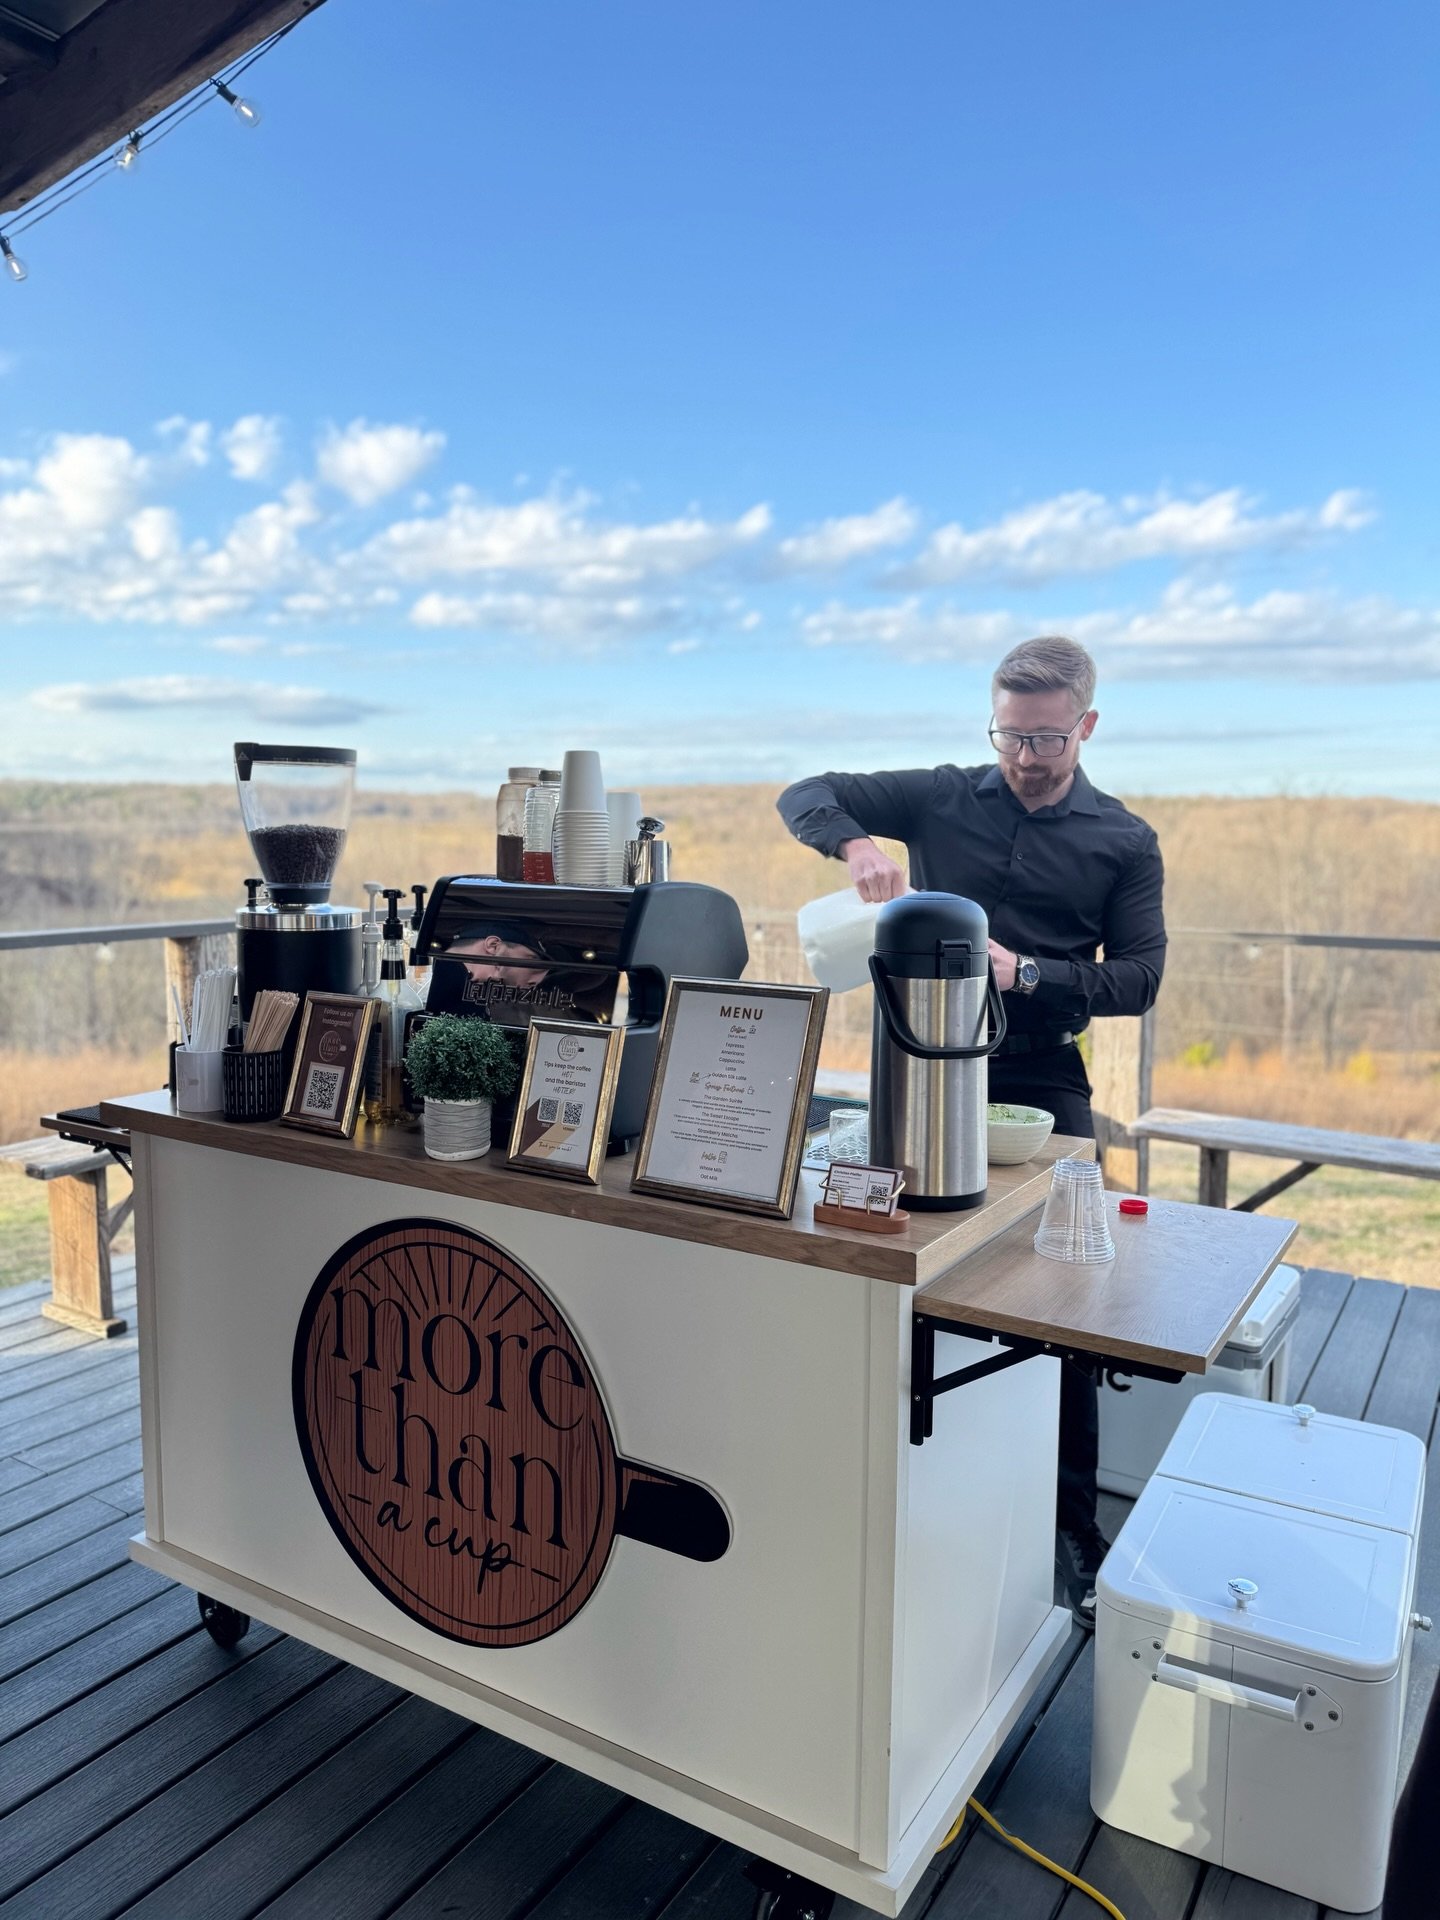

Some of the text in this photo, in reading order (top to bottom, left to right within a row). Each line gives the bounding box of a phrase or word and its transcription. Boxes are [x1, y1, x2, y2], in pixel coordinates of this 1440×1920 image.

[323, 1008, 339, 1016] Follow
[720, 1006, 763, 1020] MENU
[721, 1049, 745, 1057] Americano
[718, 1056, 746, 1065] Cappuccino
[543, 1060, 554, 1069] Tips
[554, 1062, 567, 1070] keep
[575, 1065, 592, 1073] coffee
[562, 1071, 575, 1079] HOT
[711, 1072, 728, 1080] Golden
[565, 1079, 587, 1088] baristas
[712, 1095, 729, 1103] Garden
[710, 1112, 724, 1120] Sweet
[723, 1114, 740, 1122] Escape
[697, 1127, 721, 1137] Strawberry
[700, 1173, 709, 1181] Oat
[329, 1285, 587, 1432] more
[335, 1369, 571, 1552] than
[376, 1500, 526, 1596] a cup
